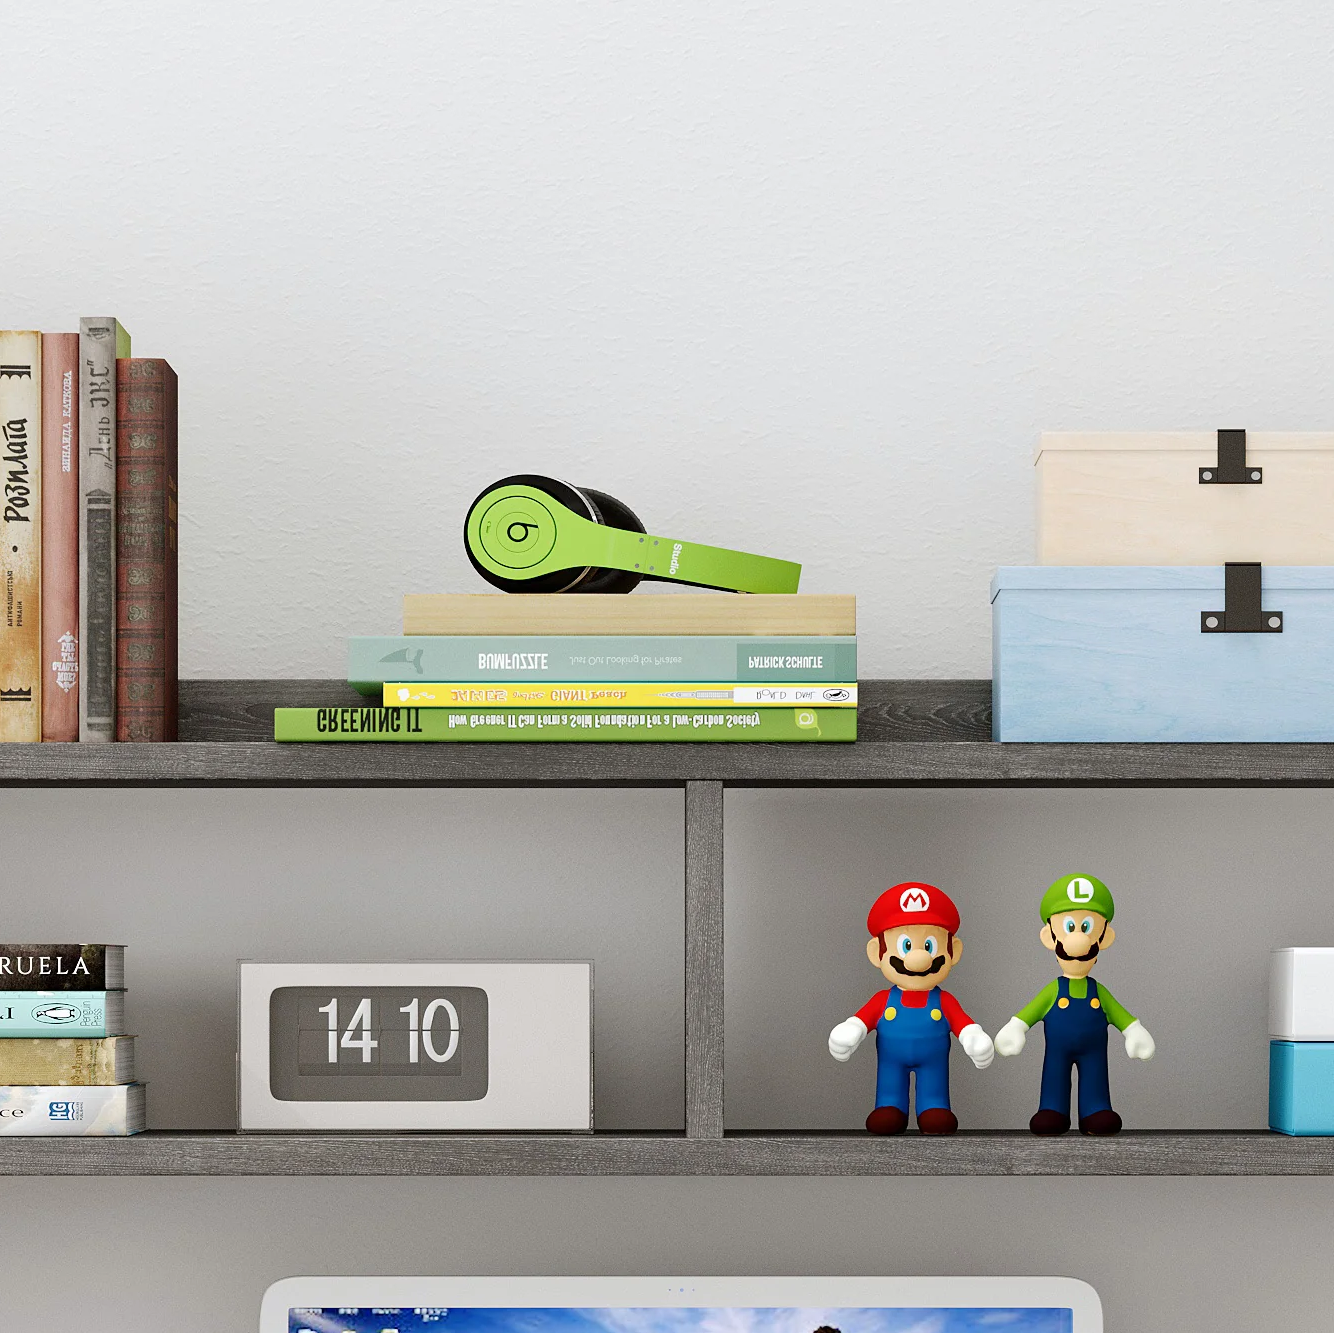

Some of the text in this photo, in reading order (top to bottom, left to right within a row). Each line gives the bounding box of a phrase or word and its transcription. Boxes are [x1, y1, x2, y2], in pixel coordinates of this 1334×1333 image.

[62, 370, 72, 417] КАТКОВА
[668, 543, 683, 575] Studio
[79, 1000, 93, 1027] Penguin
[91, 1008, 103, 1027] Press
[318, 998, 460, 1063] 14 10
[49, 1103, 68, 1120] HG
